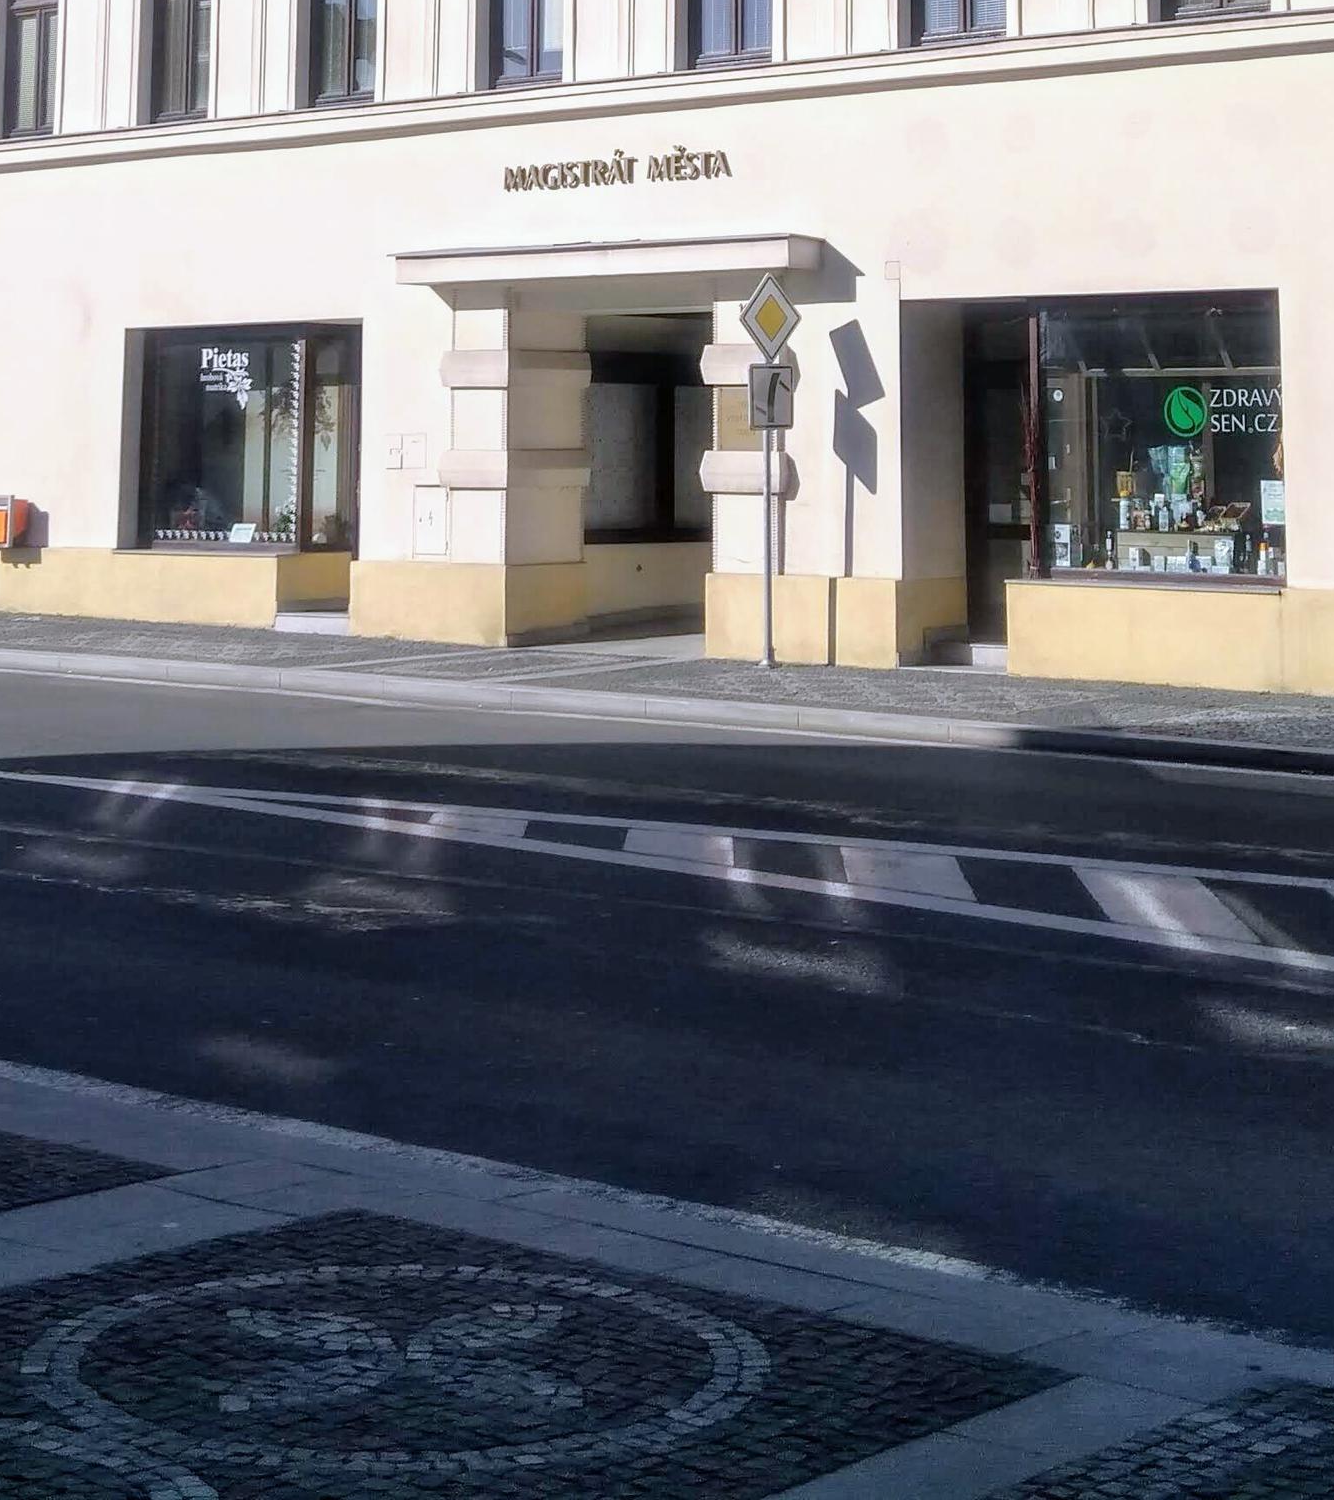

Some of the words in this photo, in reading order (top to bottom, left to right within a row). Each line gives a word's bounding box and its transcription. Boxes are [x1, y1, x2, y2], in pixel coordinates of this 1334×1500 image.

[503, 149, 638, 192] MAGISTRÁT
[647, 145, 732, 182] MĚSTA
[200, 347, 249, 369] Pietas
[1210, 413, 1279, 434] SEN.CZ
